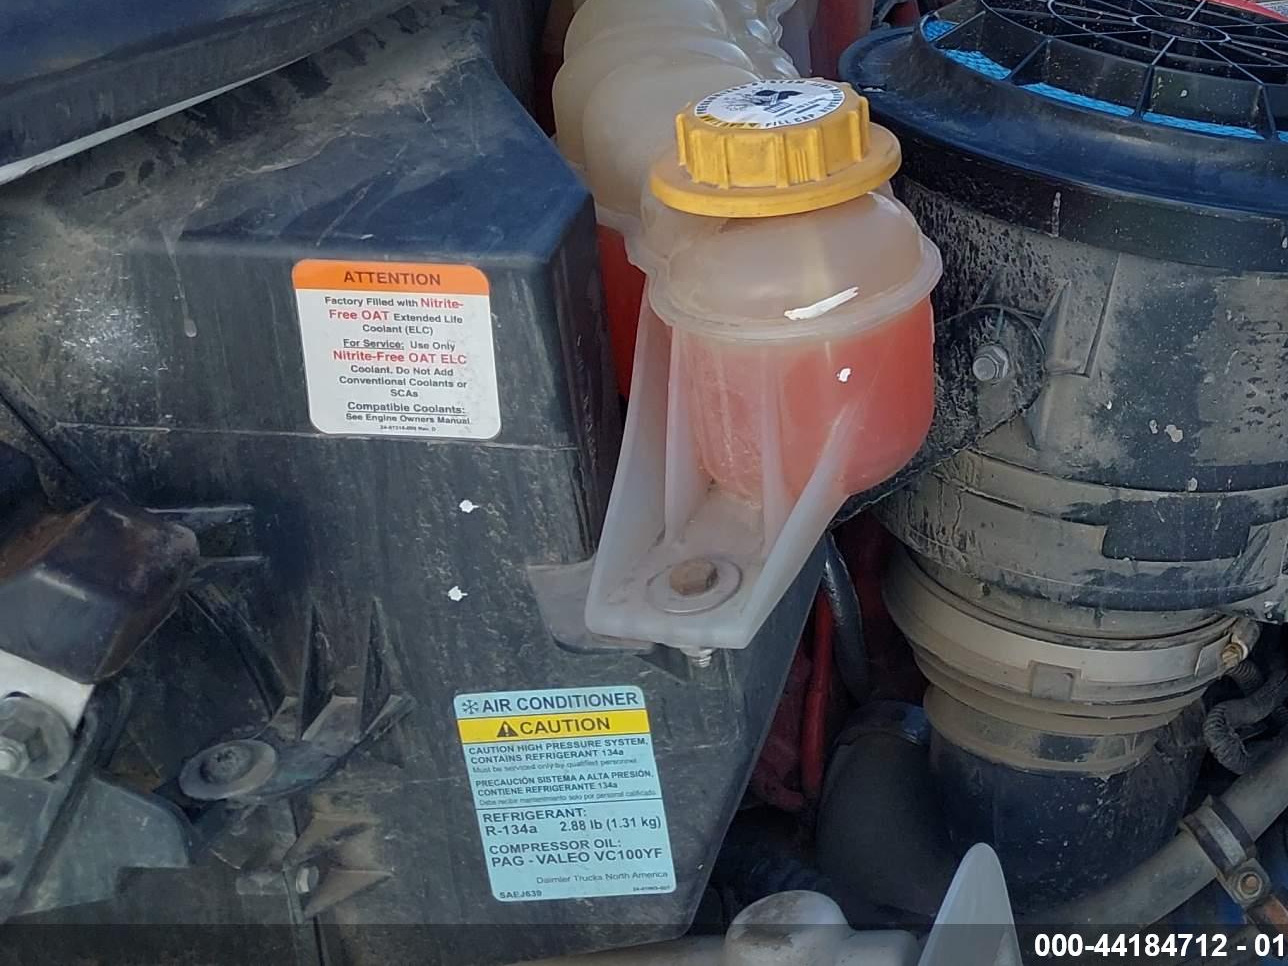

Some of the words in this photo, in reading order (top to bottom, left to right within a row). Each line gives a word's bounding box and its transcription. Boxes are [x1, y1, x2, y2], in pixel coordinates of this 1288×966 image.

[344, 271, 441, 285] ATTENTION
[325, 296, 364, 307] Factory
[367, 298, 394, 307] Filled
[397, 299, 418, 308] with
[421, 298, 464, 309] Nitrite-
[329, 310, 358, 319] Free
[362, 310, 389, 321] OAT
[394, 313, 441, 323] Extended
[445, 315, 463, 323] Life
[362, 325, 403, 333] Coolant
[405, 326, 433, 336] (ELC)
[344, 339, 360, 348] For
[363, 340, 404, 350] Service:
[410, 341, 430, 349] Use
[432, 342, 455, 351] Only
[333, 351, 404, 362] Nitrite-Free
[409, 353, 436, 363] OAT
[441, 354, 467, 364] ELC
[434, 368, 453, 376] Add
[339, 377, 406, 386] Conventional
[409, 379, 453, 387] Coolants
[390, 389, 418, 397] SCAs
[348, 402, 410, 413] Compatible
[413, 405, 465, 414] Coolants:
[366, 414, 397, 423] Engine
[400, 415, 434, 423] Owners
[482, 699, 512, 713] AIR
[517, 692, 639, 711] CONDITIONER
[520, 717, 610, 735] CAUTION
[469, 745, 515, 755] CAUTION
[517, 744, 543, 752] HIGH
[545, 740, 601, 750] PRESSURE
[470, 754, 522, 764] CONTAINS
[526, 750, 597, 761] REFRIGERANT
[476, 777, 535, 786] PRECAUCIÓN
[537, 774, 576, 783] SISTEMA
[588, 772, 609, 781] ALTA
[478, 787, 524, 797] CONTIENE
[526, 783, 595, 794] REFRIGERANTE
[483, 808, 586, 822] REFRIGERANT:
[485, 826, 537, 836] R-134a
[560, 821, 586, 832] 2.88
[590, 820, 602, 830] lb
[606, 819, 636, 831] (1.31
[641, 817, 661, 829] kg)
[489, 840, 590, 854] COMPRESSOR
[594, 839, 621, 848] OIL:
[492, 856, 524, 867] PAG
[536, 853, 590, 865] VALEO
[594, 848, 663, 861] VC100YF
[536, 876, 570, 884] Daimler
[633, 871, 668, 879] America
